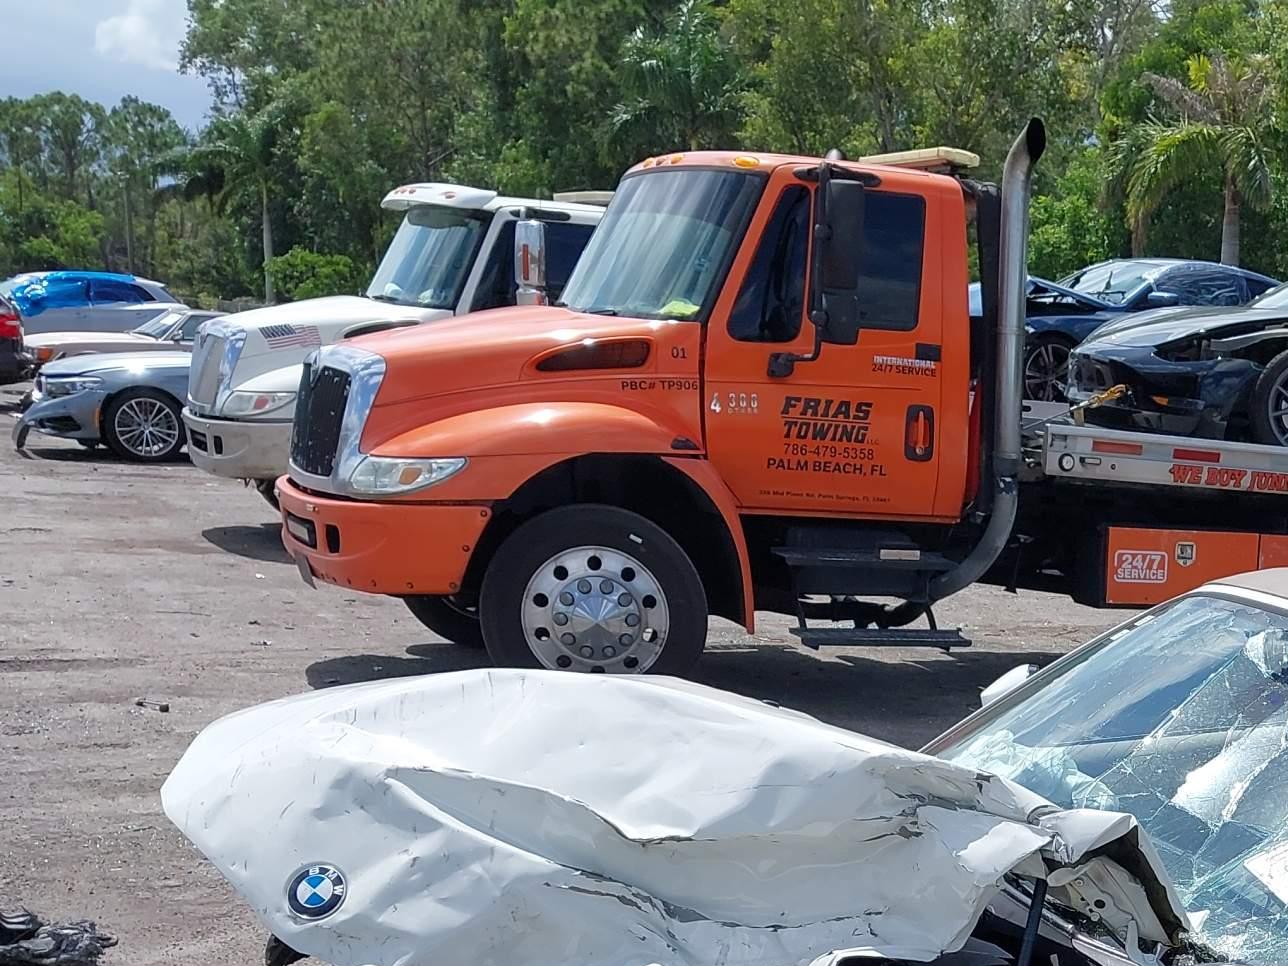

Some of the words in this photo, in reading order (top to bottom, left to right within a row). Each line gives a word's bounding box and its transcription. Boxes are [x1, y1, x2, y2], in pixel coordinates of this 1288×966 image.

[671, 347, 687, 358] 01
[873, 355, 936, 369] INTERNATIONAL
[872, 364, 893, 374] 24/7
[896, 365, 937, 378] SERVICE
[621, 380, 656, 391] PBC#
[781, 396, 873, 420] FRIAS
[783, 420, 869, 444] TOWING
[783, 443, 874, 460] 786-479-5358
[767, 457, 809, 472] PALM
[813, 461, 867, 477] BEACH,
[870, 464, 887, 477] FL
[1169, 463, 1203, 485] WE
[1204, 467, 1247, 488] BUY
[1121, 554, 1161, 570] 24/7
[1117, 568, 1164, 580] SERVICE
[308, 866, 345, 896] BMW
